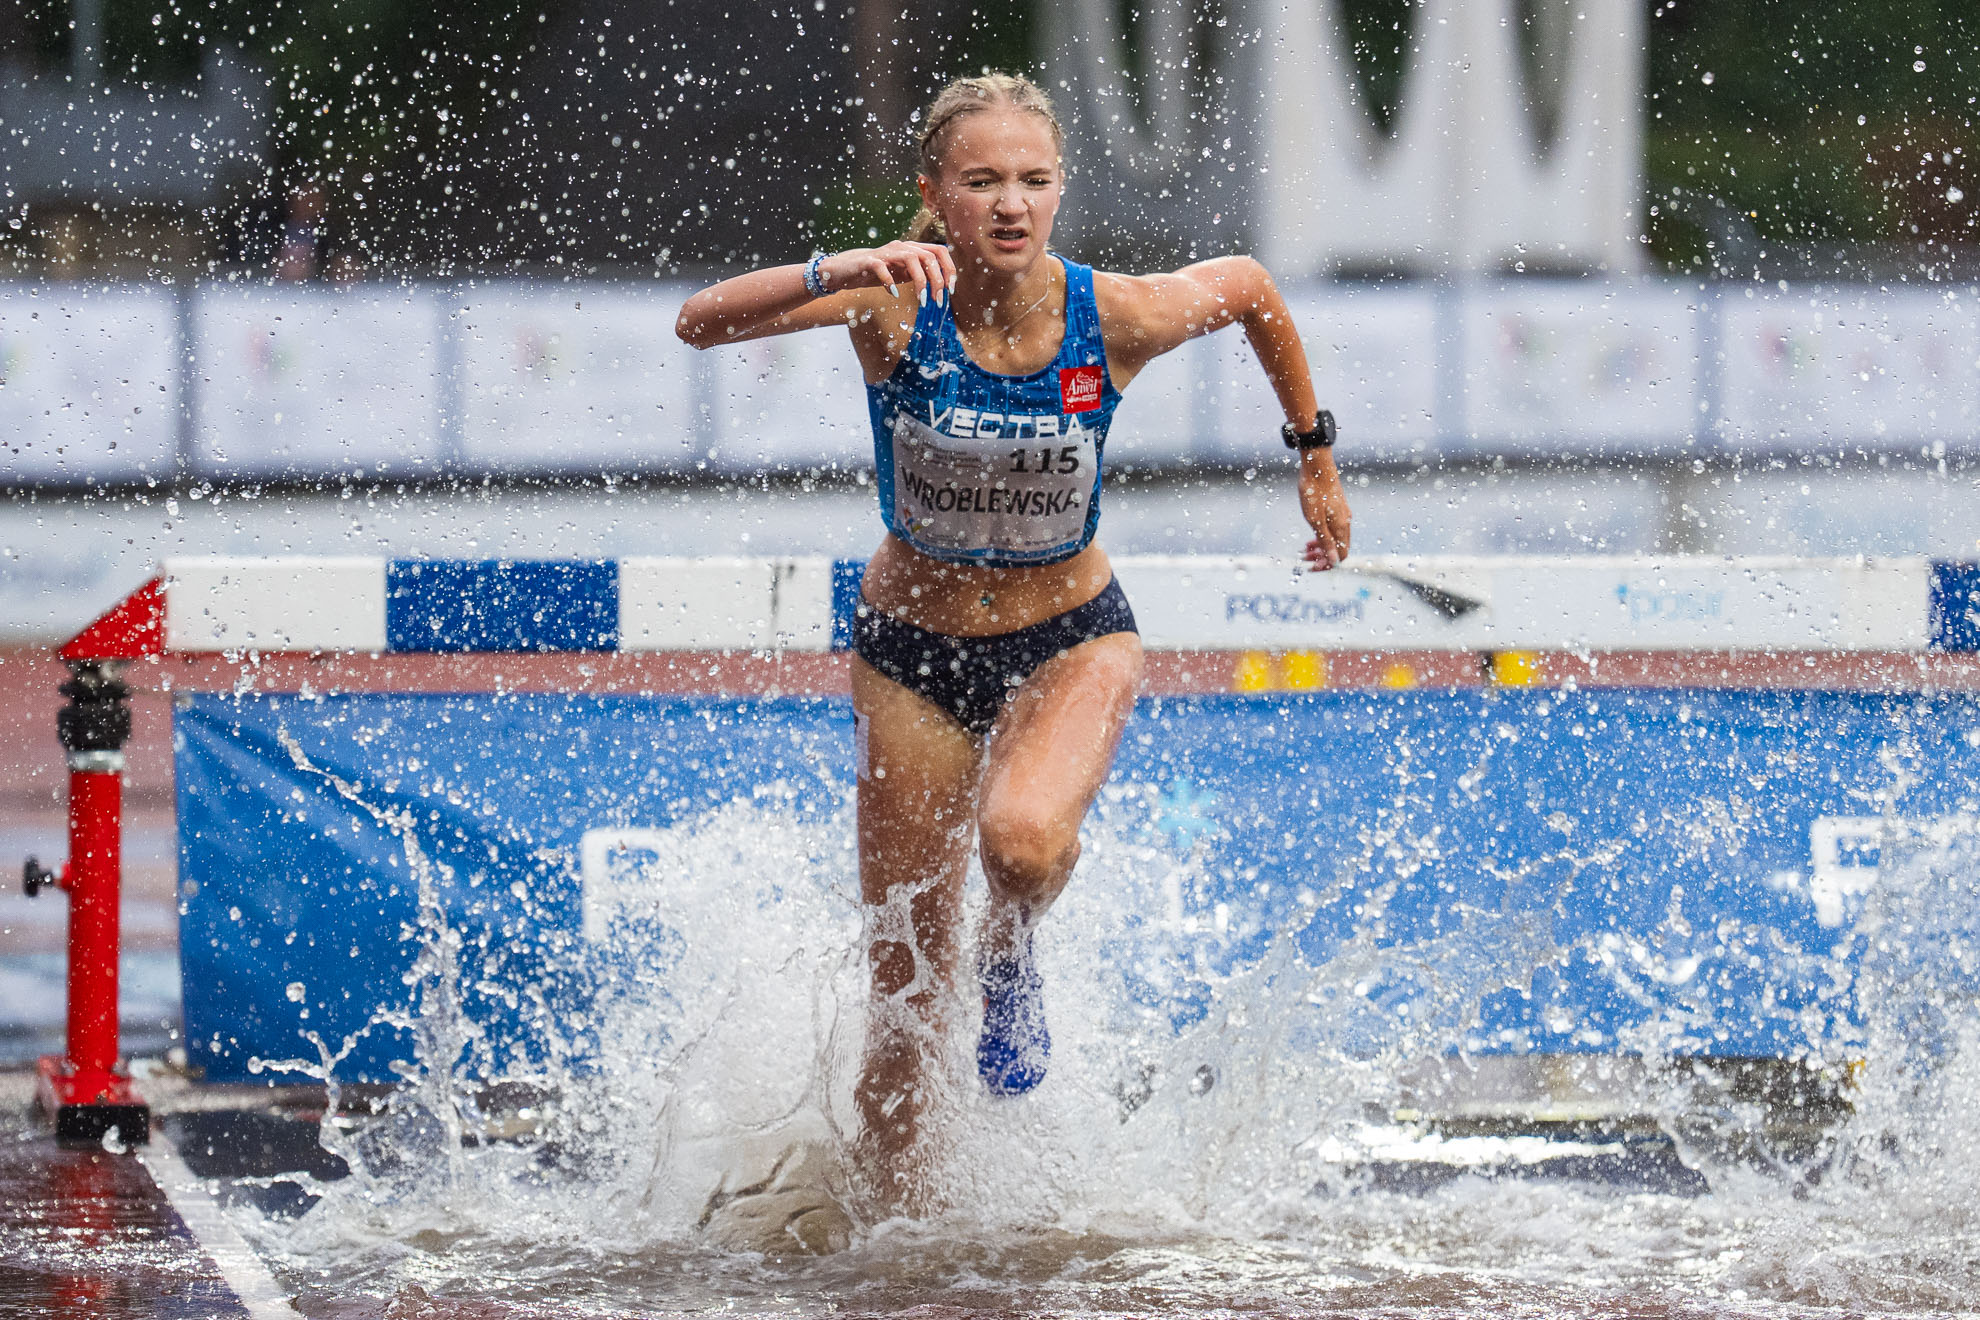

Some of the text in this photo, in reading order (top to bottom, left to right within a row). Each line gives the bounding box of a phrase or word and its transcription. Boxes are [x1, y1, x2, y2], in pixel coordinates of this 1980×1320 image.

[928, 399, 1086, 440] VECTRA
[1009, 445, 1079, 475] 115
[901, 466, 1079, 517] WRÓBLEWSKA
